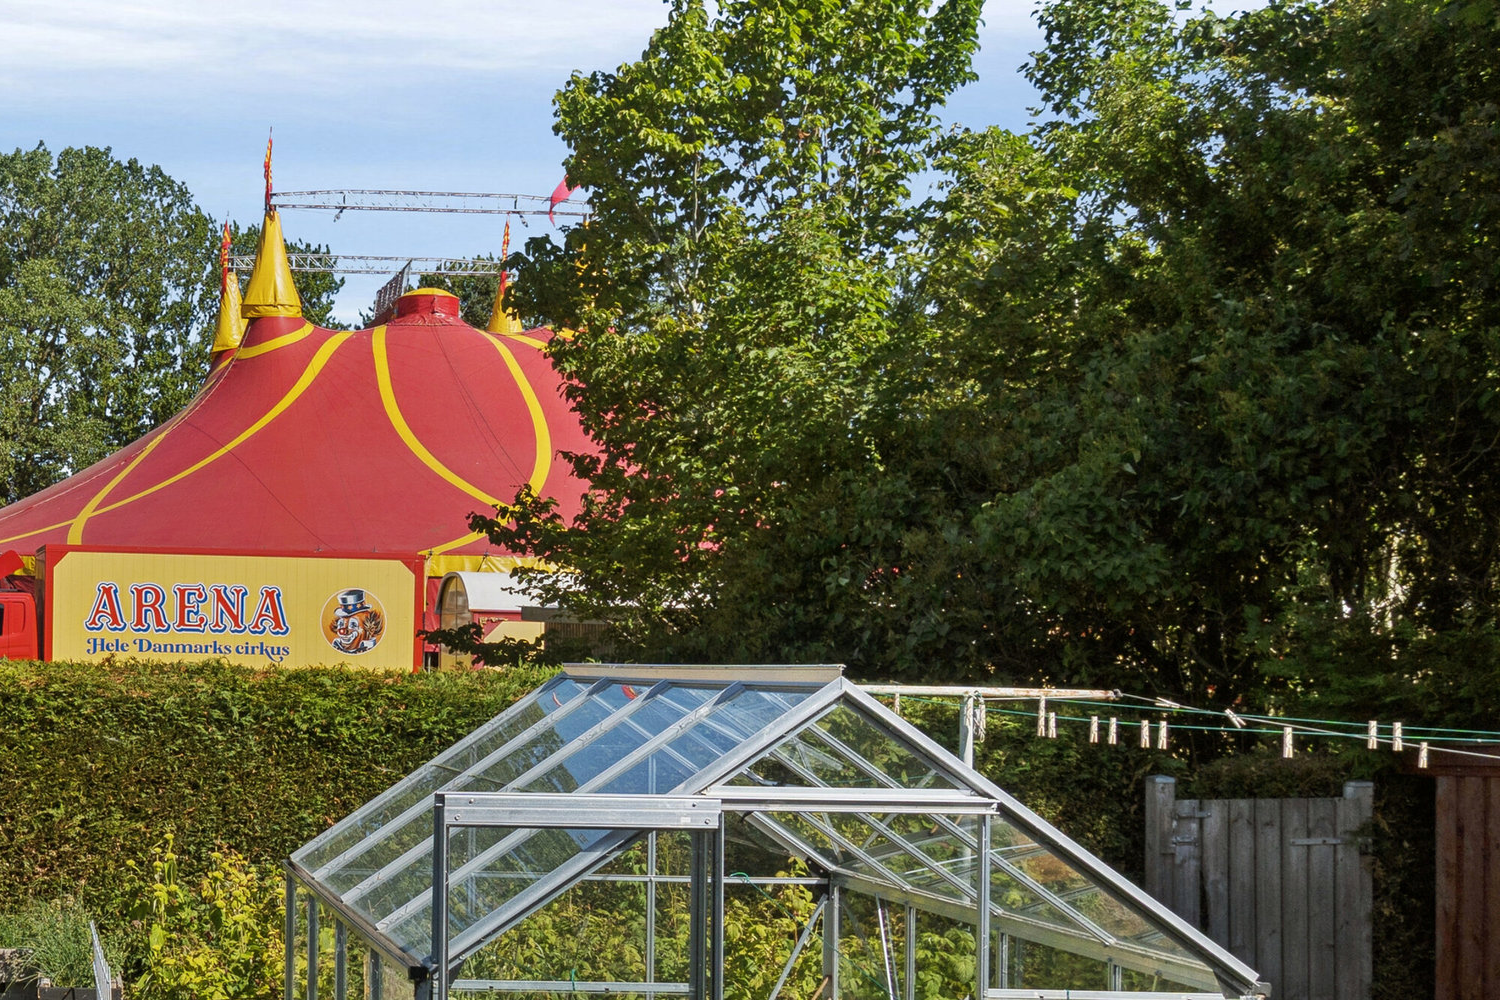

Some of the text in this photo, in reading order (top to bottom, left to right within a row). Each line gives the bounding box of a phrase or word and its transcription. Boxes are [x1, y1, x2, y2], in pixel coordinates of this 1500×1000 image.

[85, 582, 290, 636] ARENA
[87, 638, 290, 662] Hele Danmarks cirkus
